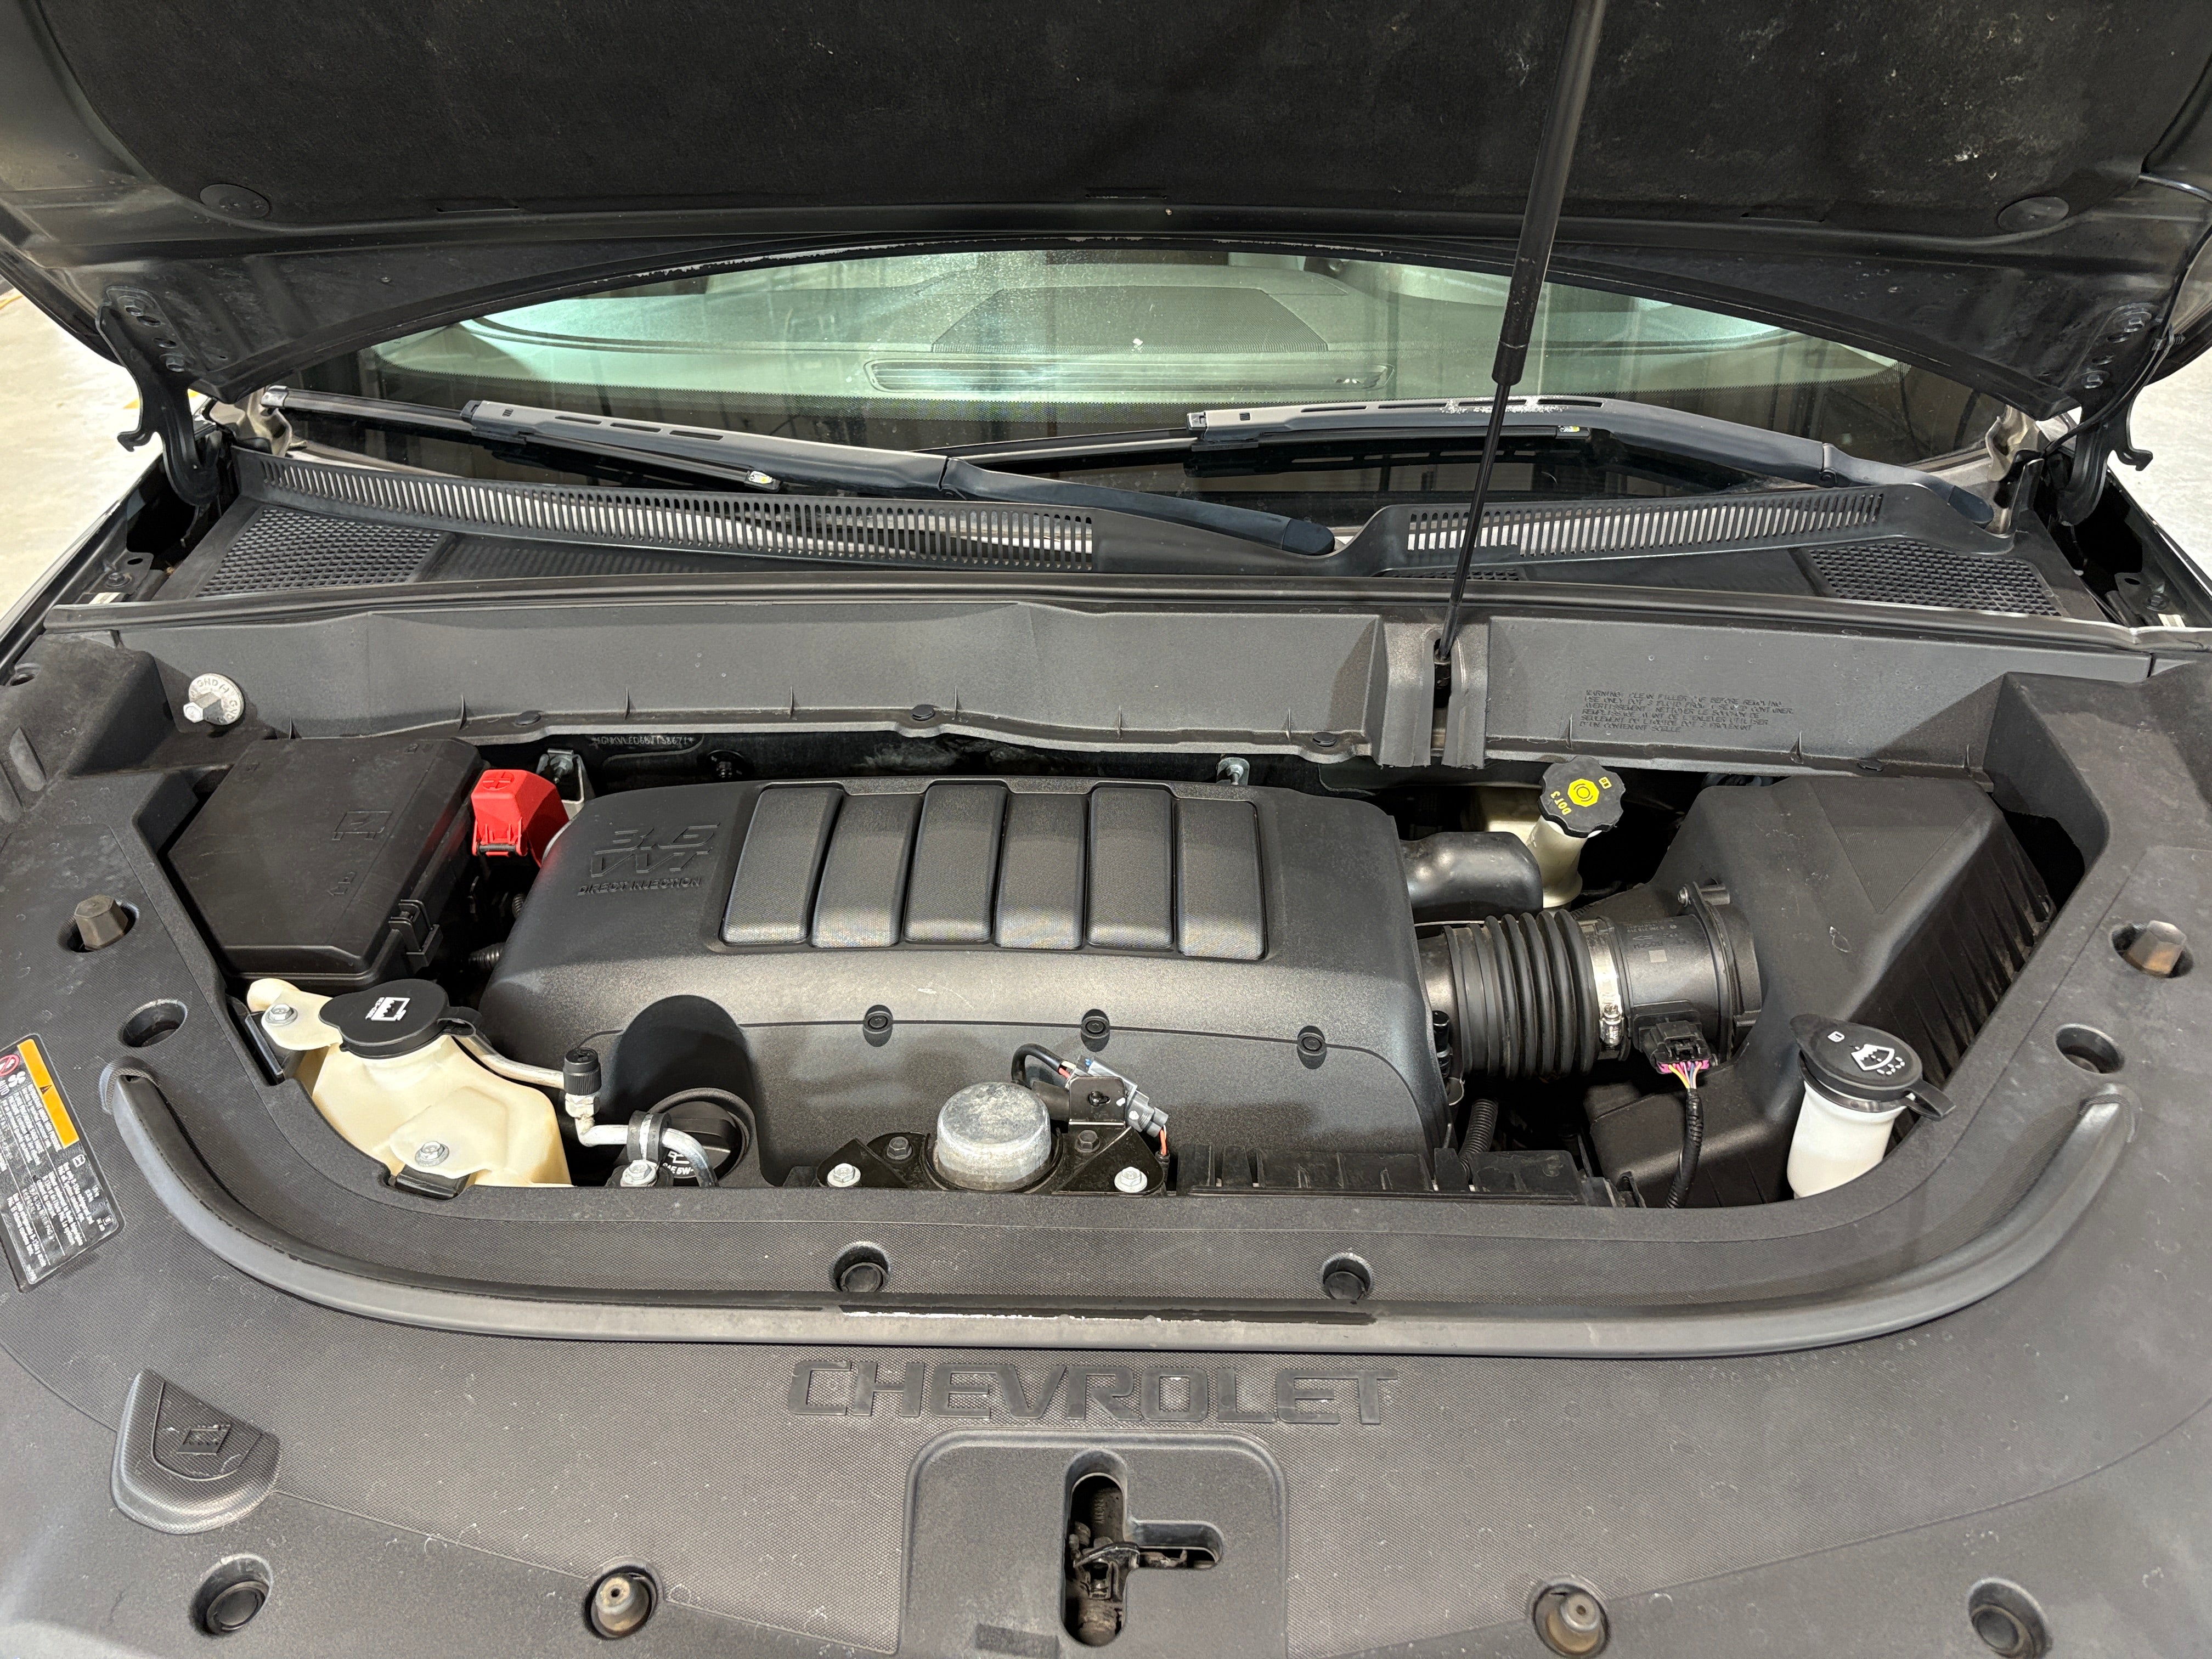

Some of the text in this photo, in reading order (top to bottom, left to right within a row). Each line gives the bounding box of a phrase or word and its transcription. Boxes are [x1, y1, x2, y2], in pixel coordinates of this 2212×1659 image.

[1550, 791, 1572, 816] DOT 3
[590, 847, 713, 878] VVT
[577, 877, 702, 896] DIRECT INJECTION
[788, 1360, 1397, 1425] CHEVROLET
